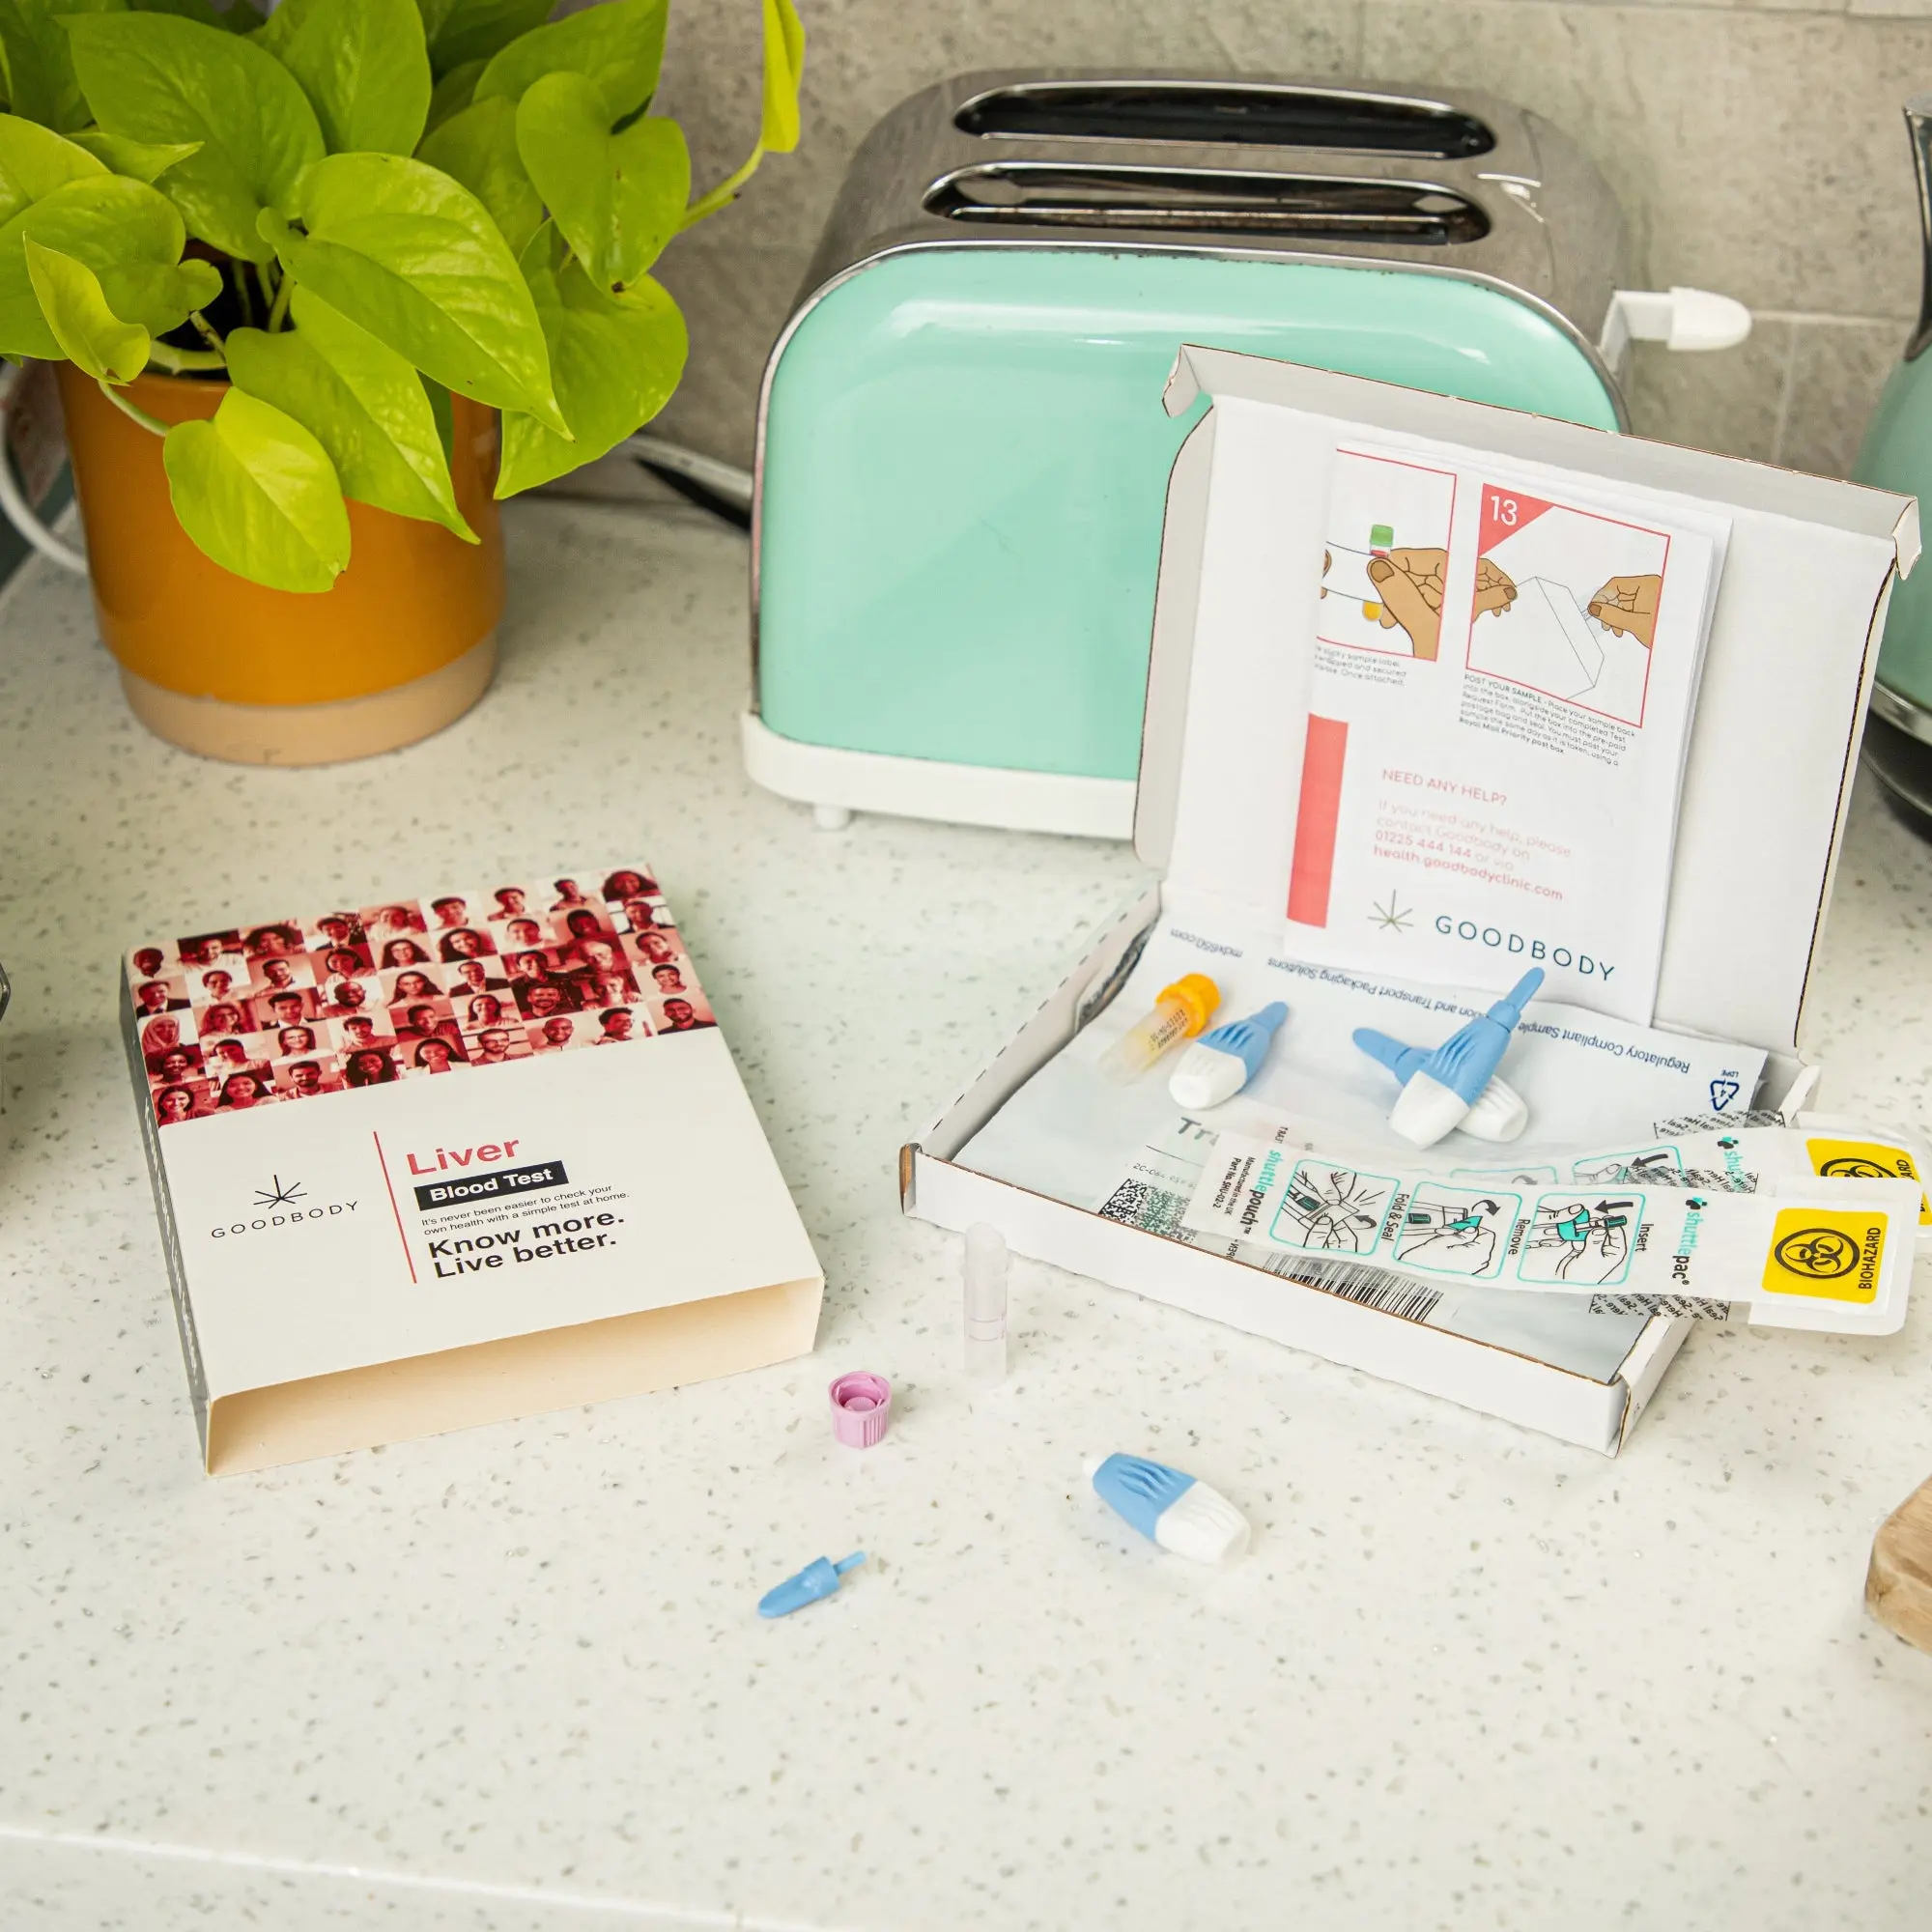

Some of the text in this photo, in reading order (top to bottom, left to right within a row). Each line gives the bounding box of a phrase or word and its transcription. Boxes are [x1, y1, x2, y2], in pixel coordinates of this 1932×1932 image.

[1491, 495, 1518, 526] 13
[1463, 673, 1486, 685] POST
[1488, 680, 1510, 692] YOUR
[1512, 687, 1543, 703] SAMPLE
[1548, 700, 1568, 714] Place
[1569, 709, 1587, 721] your
[1588, 717, 1615, 731] sample
[1616, 726, 1634, 737] back
[1463, 684, 1479, 693] into
[1480, 687, 1493, 696] the
[1512, 696, 1549, 716] alongside
[1549, 711, 1566, 722] your
[1569, 718, 1608, 737] completed
[1610, 731, 1627, 744] Test
[1463, 690, 1493, 705] Request
[1534, 713, 1547, 723] the
[1548, 718, 1561, 728] box
[1562, 724, 1577, 734] into
[1578, 729, 1592, 740] the
[1592, 735, 1627, 753] pre-paid
[1459, 716, 1481, 729] Royal
[1482, 723, 1500, 734] Mail
[1500, 726, 1531, 743] Priority
[1531, 738, 1548, 750] post
[1460, 709, 1488, 722] sample
[1490, 716, 1503, 725] the
[1504, 721, 1526, 731] same
[1526, 727, 1542, 740] day
[1591, 752, 1612, 766] using
[1461, 700, 1493, 714] postage
[1494, 708, 1511, 721] bag
[1512, 714, 1528, 725] and
[1548, 725, 1561, 737] You
[1562, 732, 1581, 744] must
[1582, 740, 1600, 752] post
[1601, 747, 1618, 758] your
[1381, 769, 1508, 807] NEED ANY HELP?
[1377, 816, 1531, 862] contact Goodbody on
[1378, 799, 1572, 859] If you need any help, please
[1376, 830, 1515, 872] 01225 444 144 or via
[1374, 844, 1564, 902] health.goodbodyclinic.com
[1266, 955, 1319, 980] Solutions
[1435, 914, 1615, 982] GOODBODY
[1320, 968, 1378, 996] Packaging
[1378, 984, 1434, 1010] Transport
[1435, 999, 1457, 1015] and
[1518, 1019, 1690, 1075] Regulatory Compliant Sample
[1720, 1068, 1740, 1078] LDPE
[407, 1138, 520, 1176] Liver
[1234, 1155, 1256, 1195] Manufactured
[429, 1168, 554, 1202] Blood Test
[1211, 1156, 1242, 1209] Part No. SHU-02-2
[1226, 1197, 1236, 1208] the
[211, 1200, 359, 1239] GOODBODY
[421, 1184, 612, 1226] It's never been easier to check your
[423, 1226, 447, 1236] own
[449, 1218, 484, 1231] health
[487, 1212, 509, 1224] with
[522, 1205, 556, 1219] simple
[559, 1200, 581, 1210] test
[582, 1197, 594, 1206] at
[595, 1191, 631, 1203] home.
[1222, 1206, 1235, 1216] UK
[1380, 1193, 1410, 1241] Fold & Seal
[429, 1211, 625, 1259] Know more.
[434, 1233, 617, 1278] Live better.
[1507, 1218, 1531, 1256] Remove
[1634, 1223, 1655, 1252] Insert
[1858, 1227, 1881, 1291] BIOHAZARD
